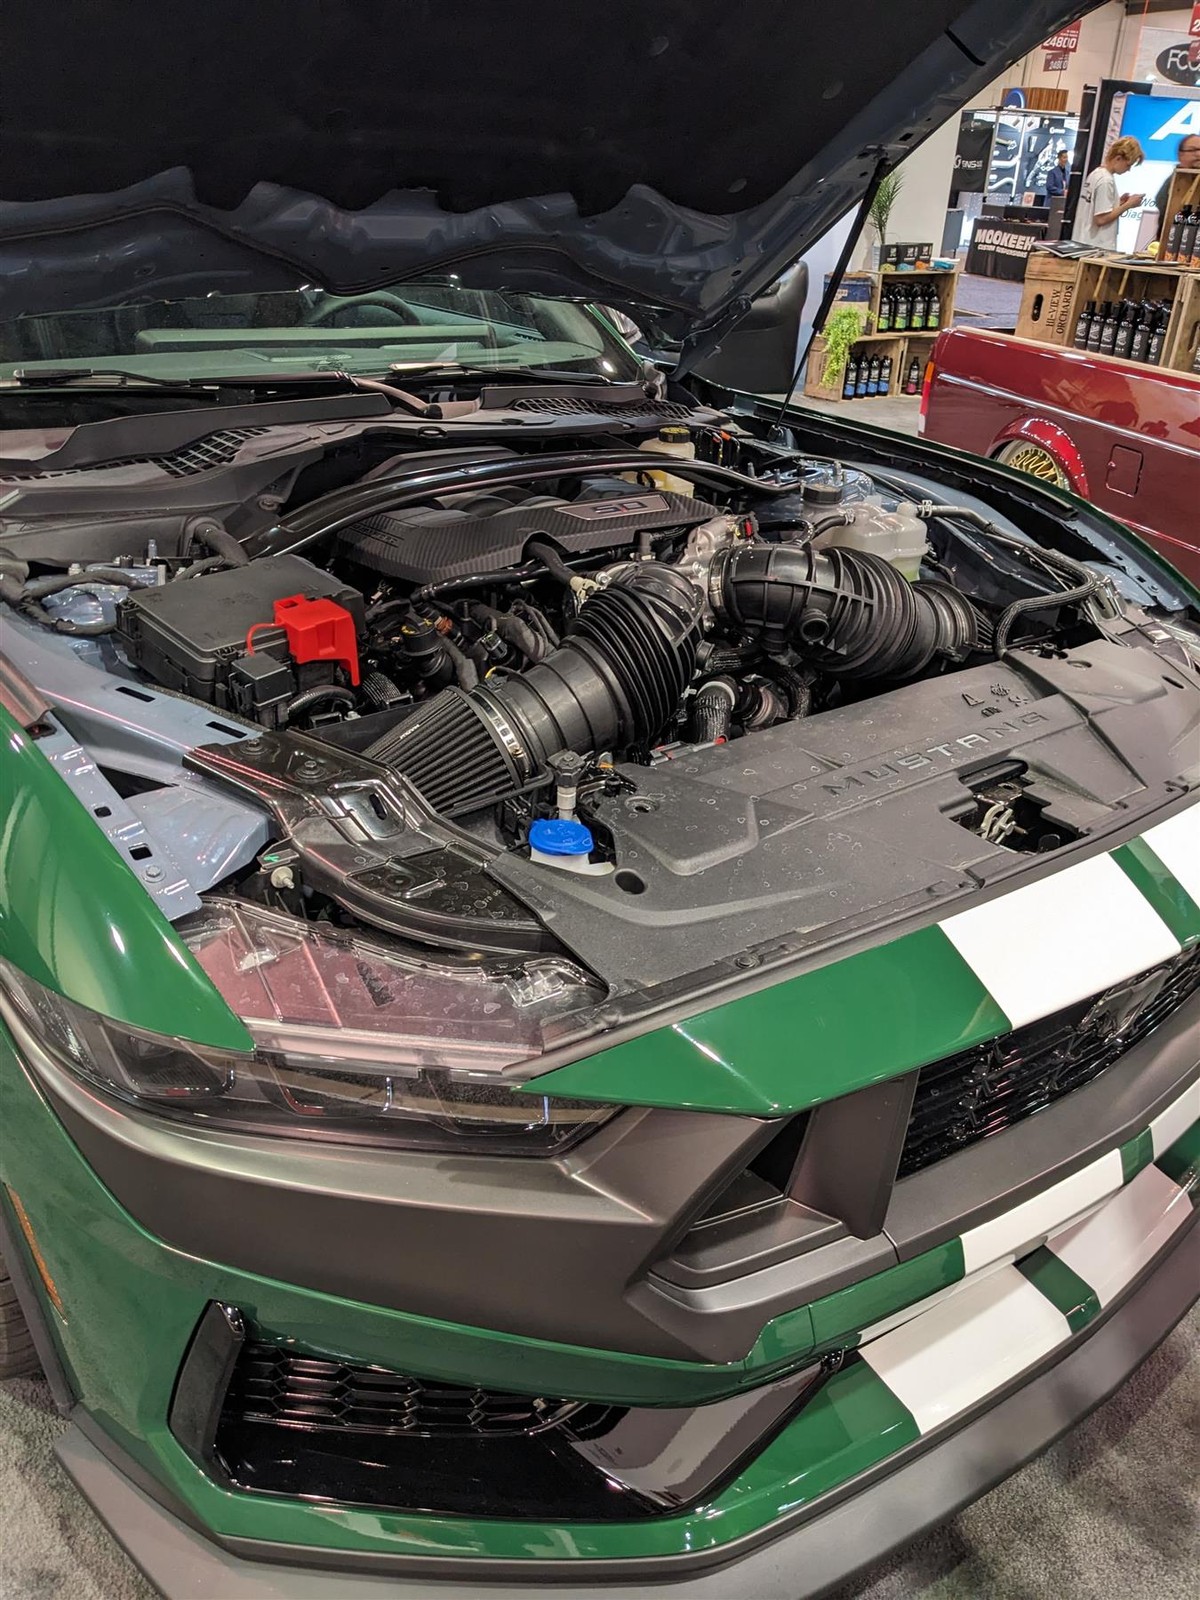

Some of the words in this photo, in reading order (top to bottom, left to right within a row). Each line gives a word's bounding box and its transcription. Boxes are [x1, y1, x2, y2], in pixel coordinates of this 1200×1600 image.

[1045, 289, 1061, 327] HI-VIEW
[1056, 285, 1073, 335] ORCHARDS
[820, 711, 1049, 797] MUSTANG
